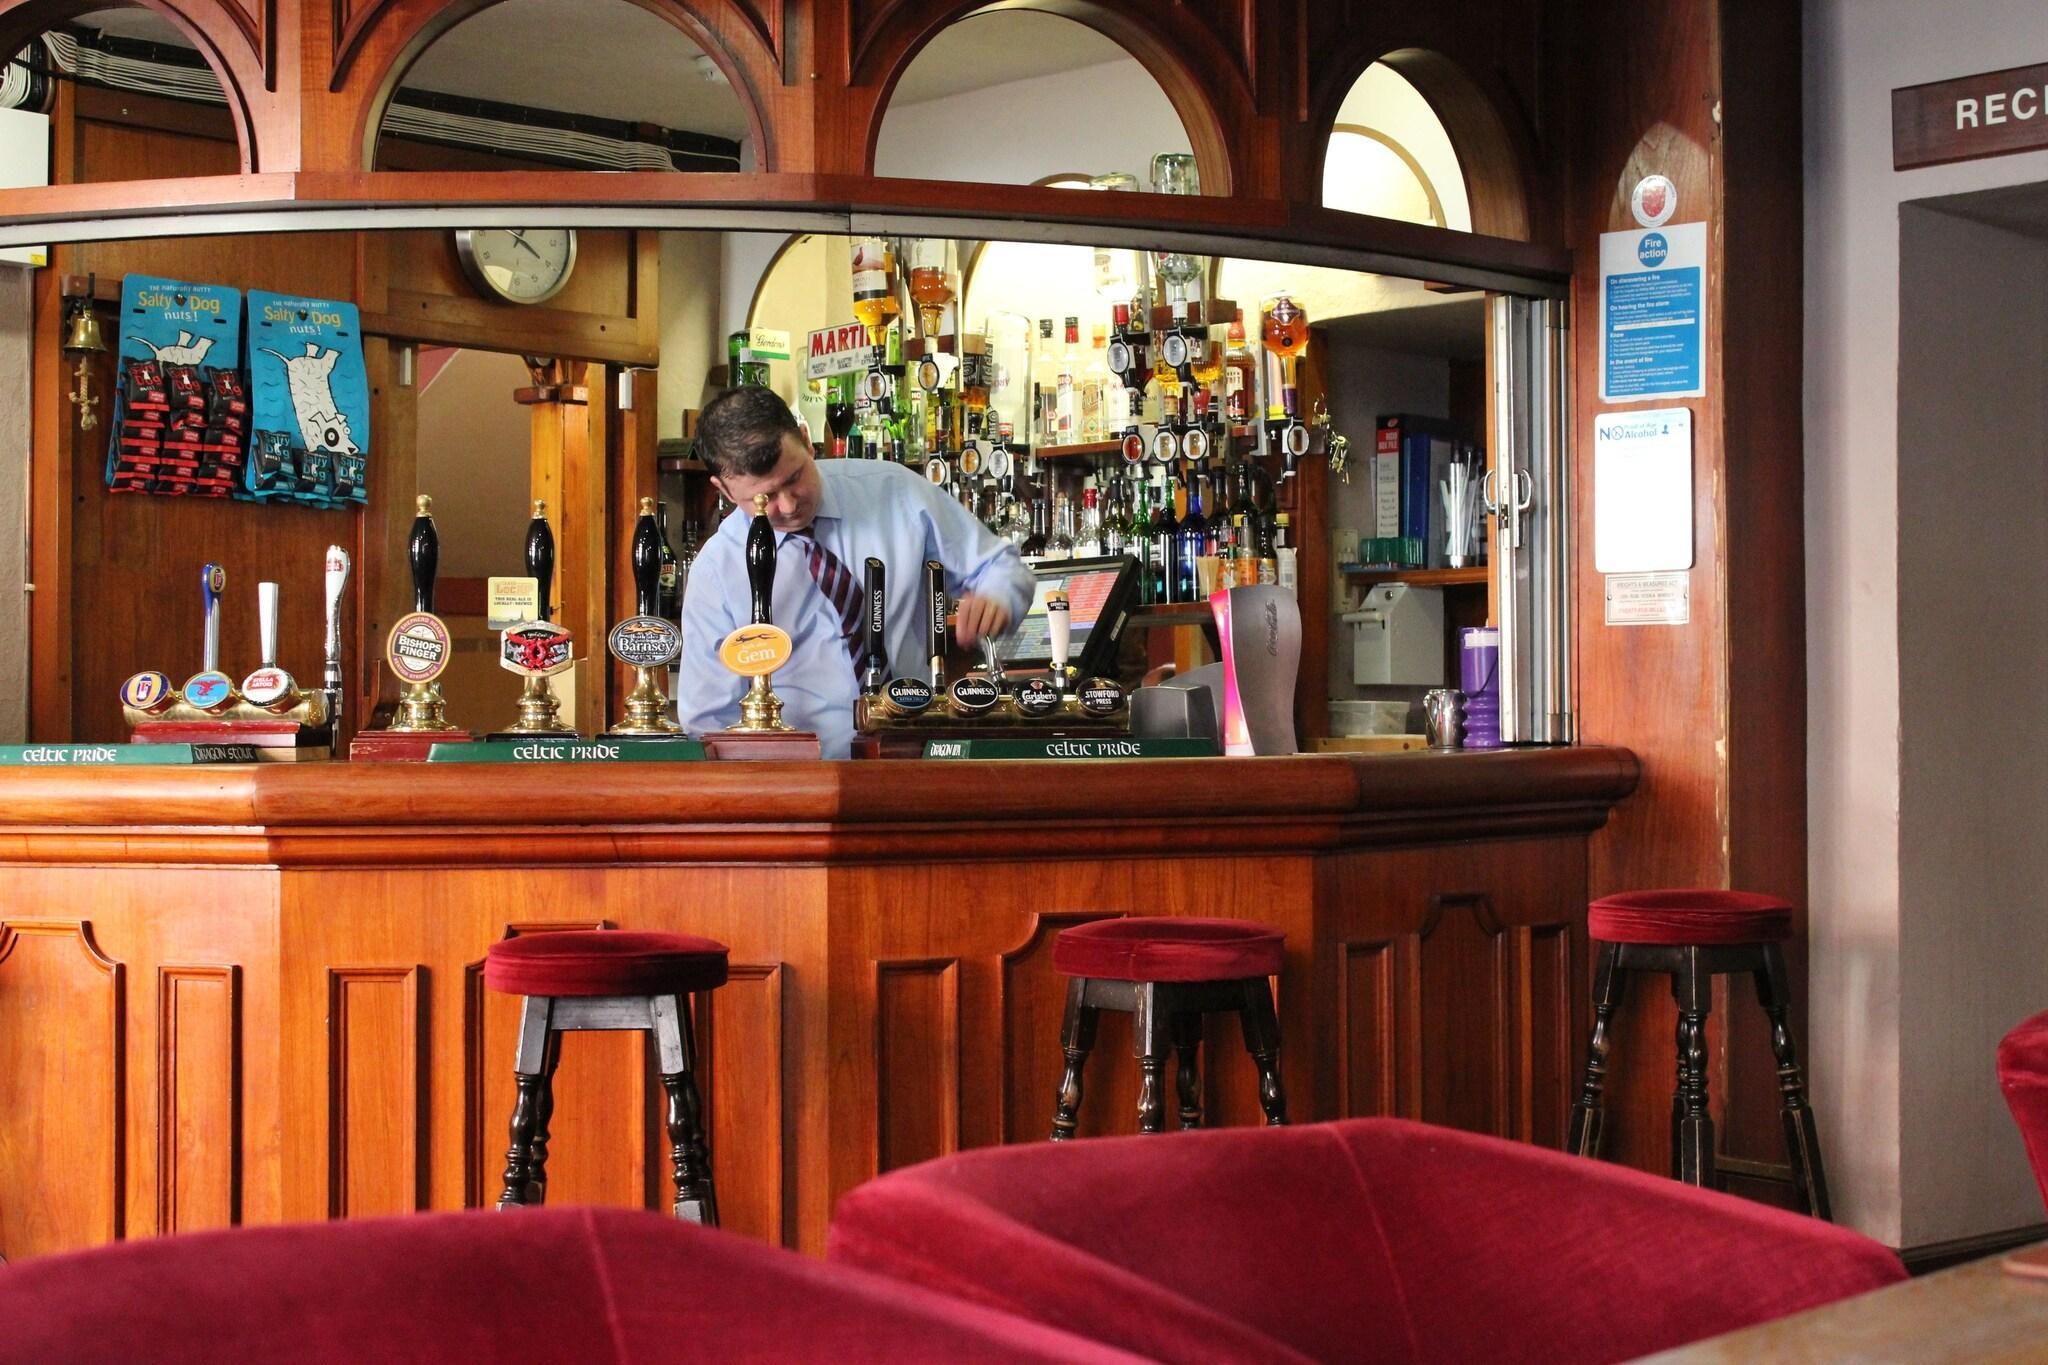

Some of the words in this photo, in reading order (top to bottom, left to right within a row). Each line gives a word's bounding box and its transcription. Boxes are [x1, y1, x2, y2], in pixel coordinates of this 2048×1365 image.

[1644, 239, 1662, 248] Fire
[1639, 248, 1667, 260] action
[138, 291, 172, 310] Salty
[190, 295, 220, 314] Dog
[164, 311, 198, 322] nuts!
[263, 305, 295, 324] Salty
[311, 311, 341, 328] Dog
[289, 325, 321, 336] nuts!
[811, 324, 871, 358] MARTI
[1624, 428, 1657, 440] Alcohol
[872, 589, 882, 632] GUINNESS
[935, 591, 944, 634] GUINNESS
[398, 635, 442, 653] BISHOPS
[399, 645, 437, 661] FINGER
[737, 648, 776, 664] Gem
[891, 687, 929, 697] GUINNESS
[957, 687, 995, 696] GUINNESS
[1021, 689, 1057, 704] Carlsberg
[1085, 690, 1120, 699] STOWFORD
[930, 742, 953, 757] DRAGON
